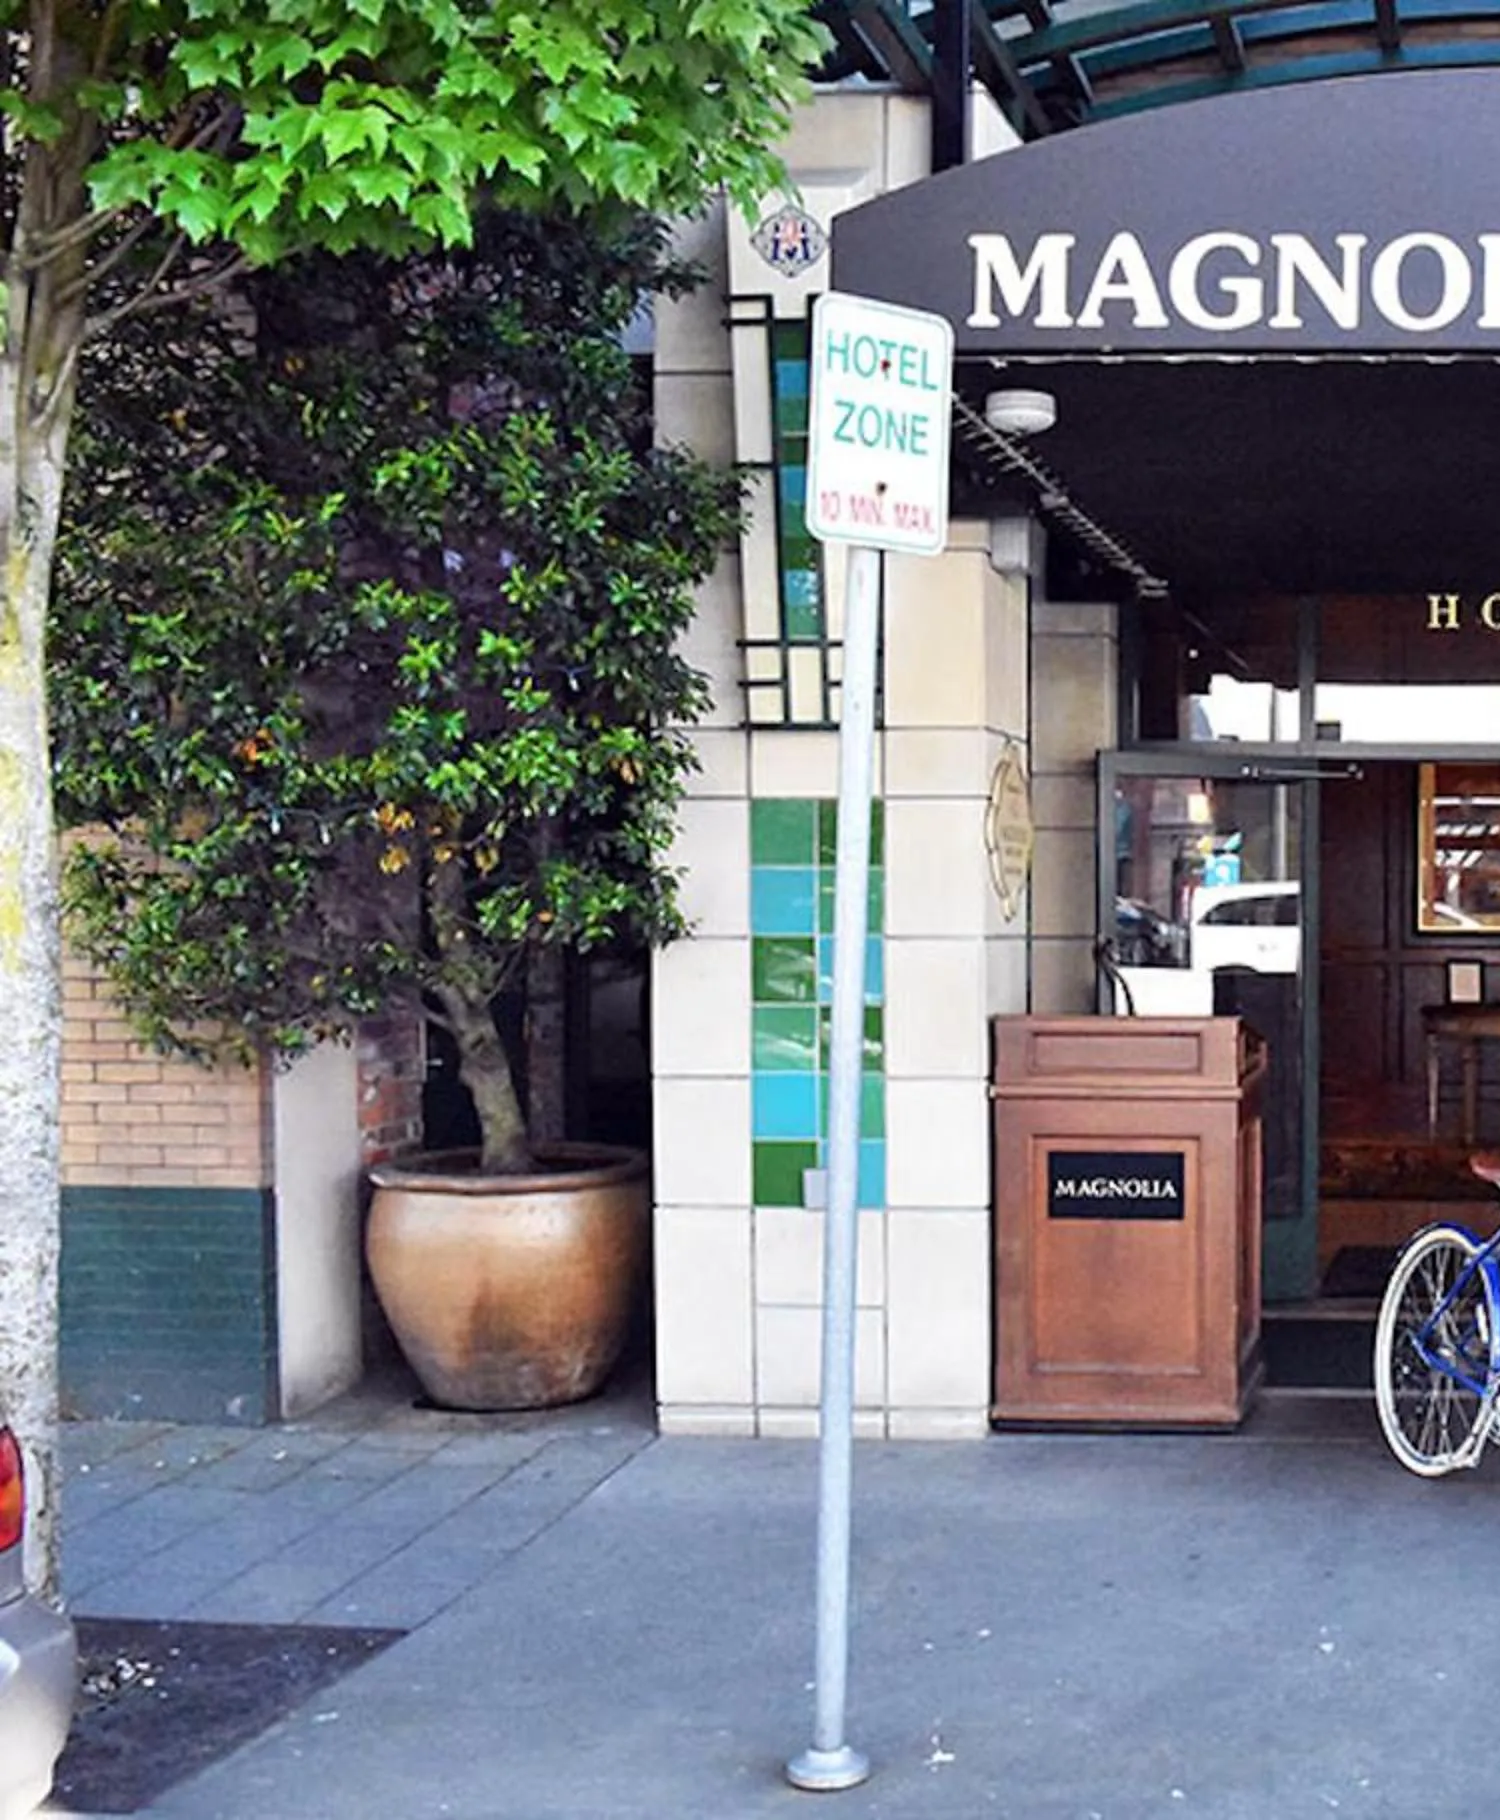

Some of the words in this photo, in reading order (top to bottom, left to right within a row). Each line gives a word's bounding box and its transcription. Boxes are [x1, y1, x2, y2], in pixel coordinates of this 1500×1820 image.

[827, 329, 938, 391] HOTEL
[832, 399, 929, 456] ZONE
[820, 490, 841, 522] 10
[1055, 1177, 1177, 1199] MAGNOLIA
